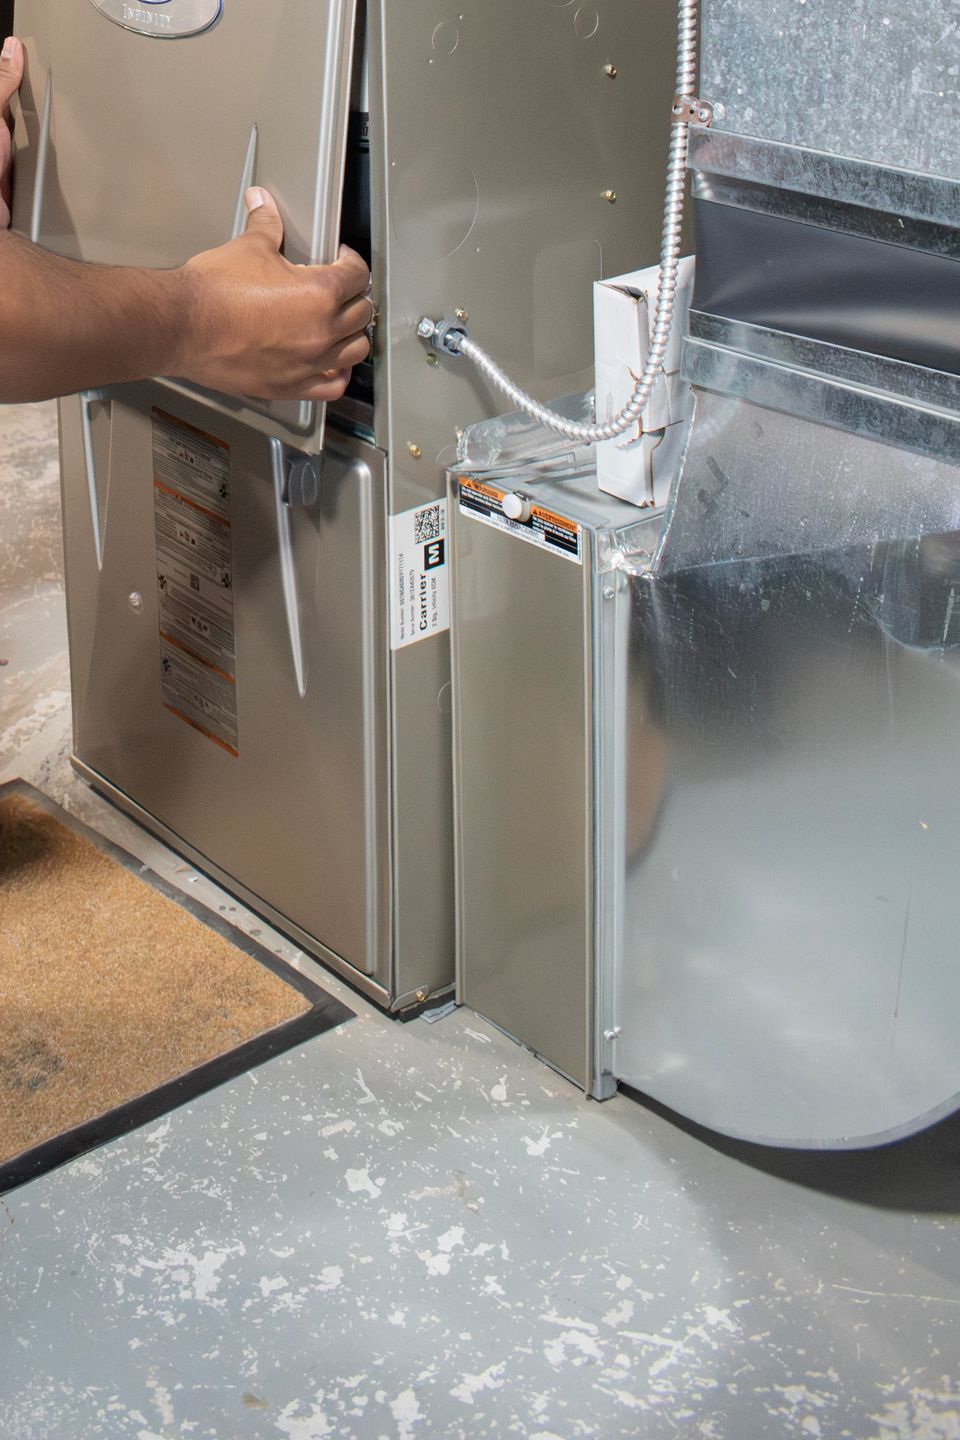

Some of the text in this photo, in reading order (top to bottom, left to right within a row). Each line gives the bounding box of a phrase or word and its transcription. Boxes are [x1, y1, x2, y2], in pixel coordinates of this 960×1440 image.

[122, 4, 175, 28] INFINITY
[428, 544, 440, 564] M
[418, 573, 428, 631] Carrier
